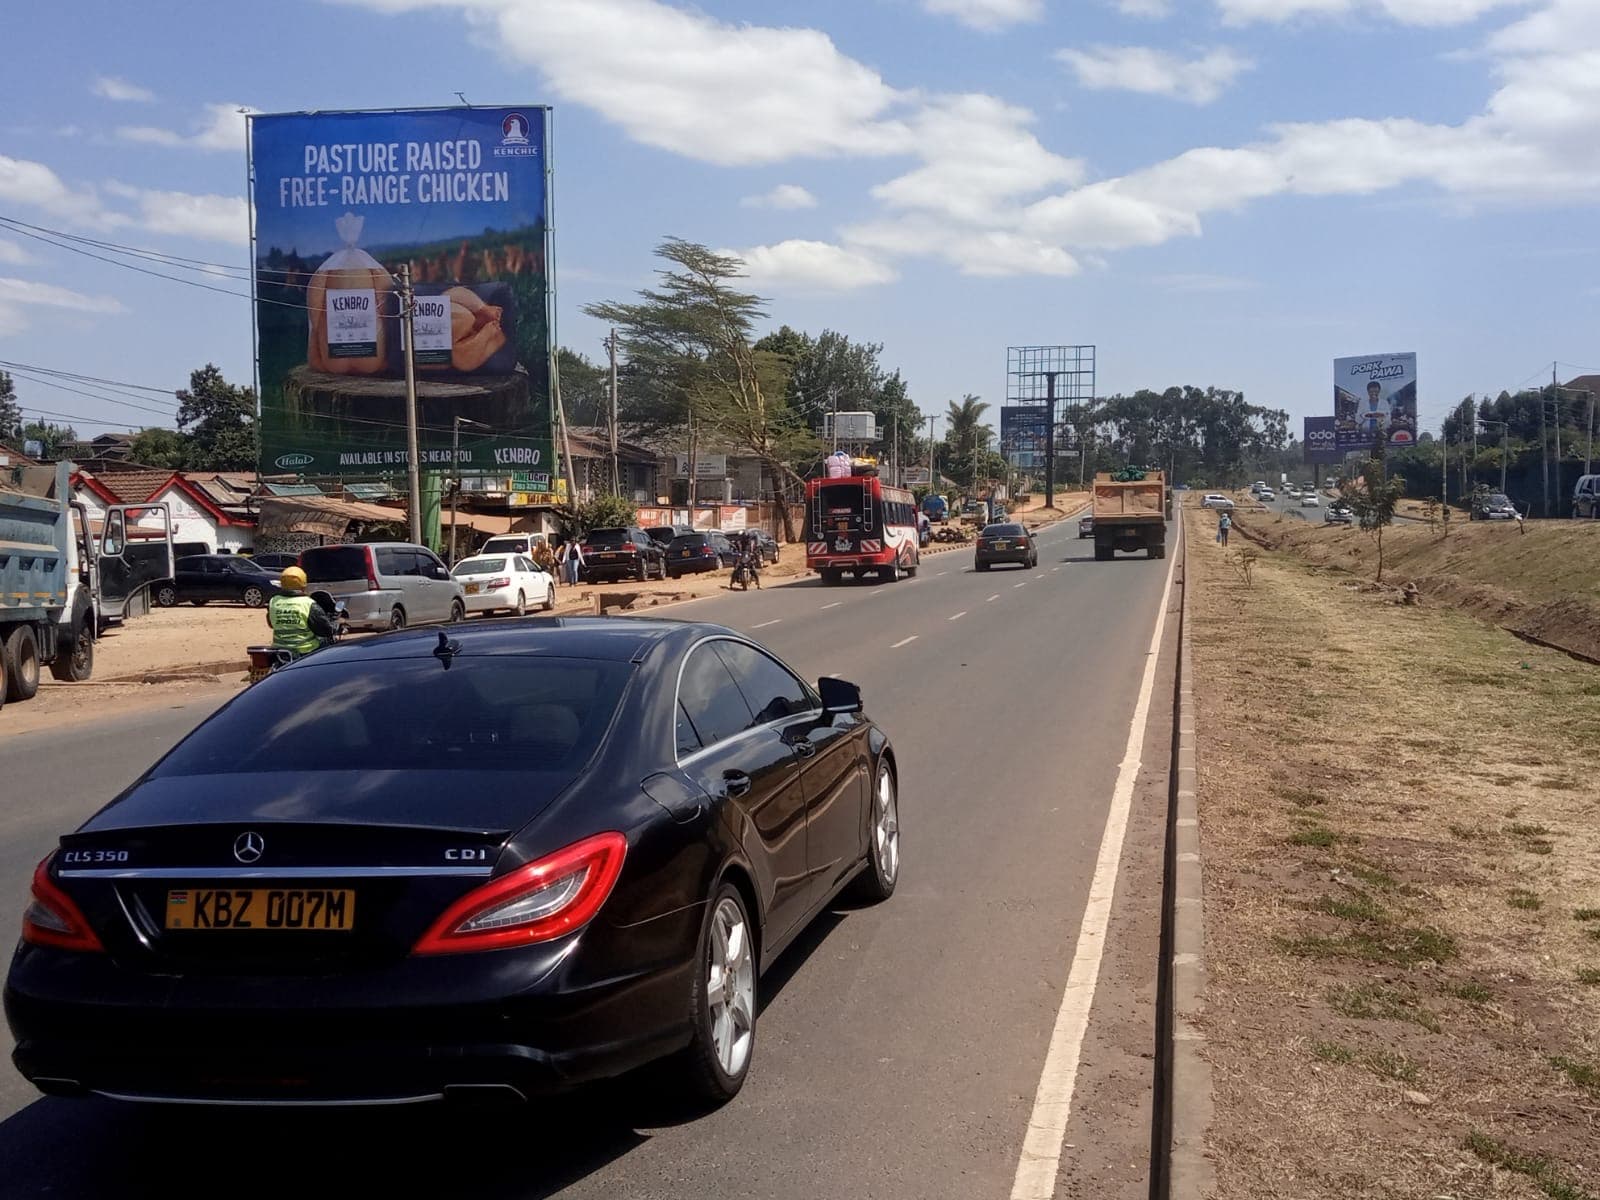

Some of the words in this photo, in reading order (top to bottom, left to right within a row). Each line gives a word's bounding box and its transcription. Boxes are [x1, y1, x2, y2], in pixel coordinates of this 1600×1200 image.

[304, 143, 399, 174] PASTURE
[406, 139, 481, 171] RAISED
[279, 174, 411, 208] FREE-RANGE
[417, 171, 509, 203] CHICKEN
[332, 296, 369, 311] KENBRO
[413, 303, 444, 318] ENBRO
[1350, 360, 1384, 375] PORK
[1370, 365, 1404, 380] PAWA
[1308, 429, 1336, 441] odo
[340, 452, 383, 465] AVAILABLE
[384, 451, 393, 463] IN
[429, 450, 452, 462] NEAR
[494, 447, 541, 465] KENBRO
[64, 851, 92, 863] CLS
[95, 850, 129, 862] 350
[444, 848, 486, 860] CDI
[193, 891, 253, 928] KBZ
[266, 891, 347, 928] 007M
